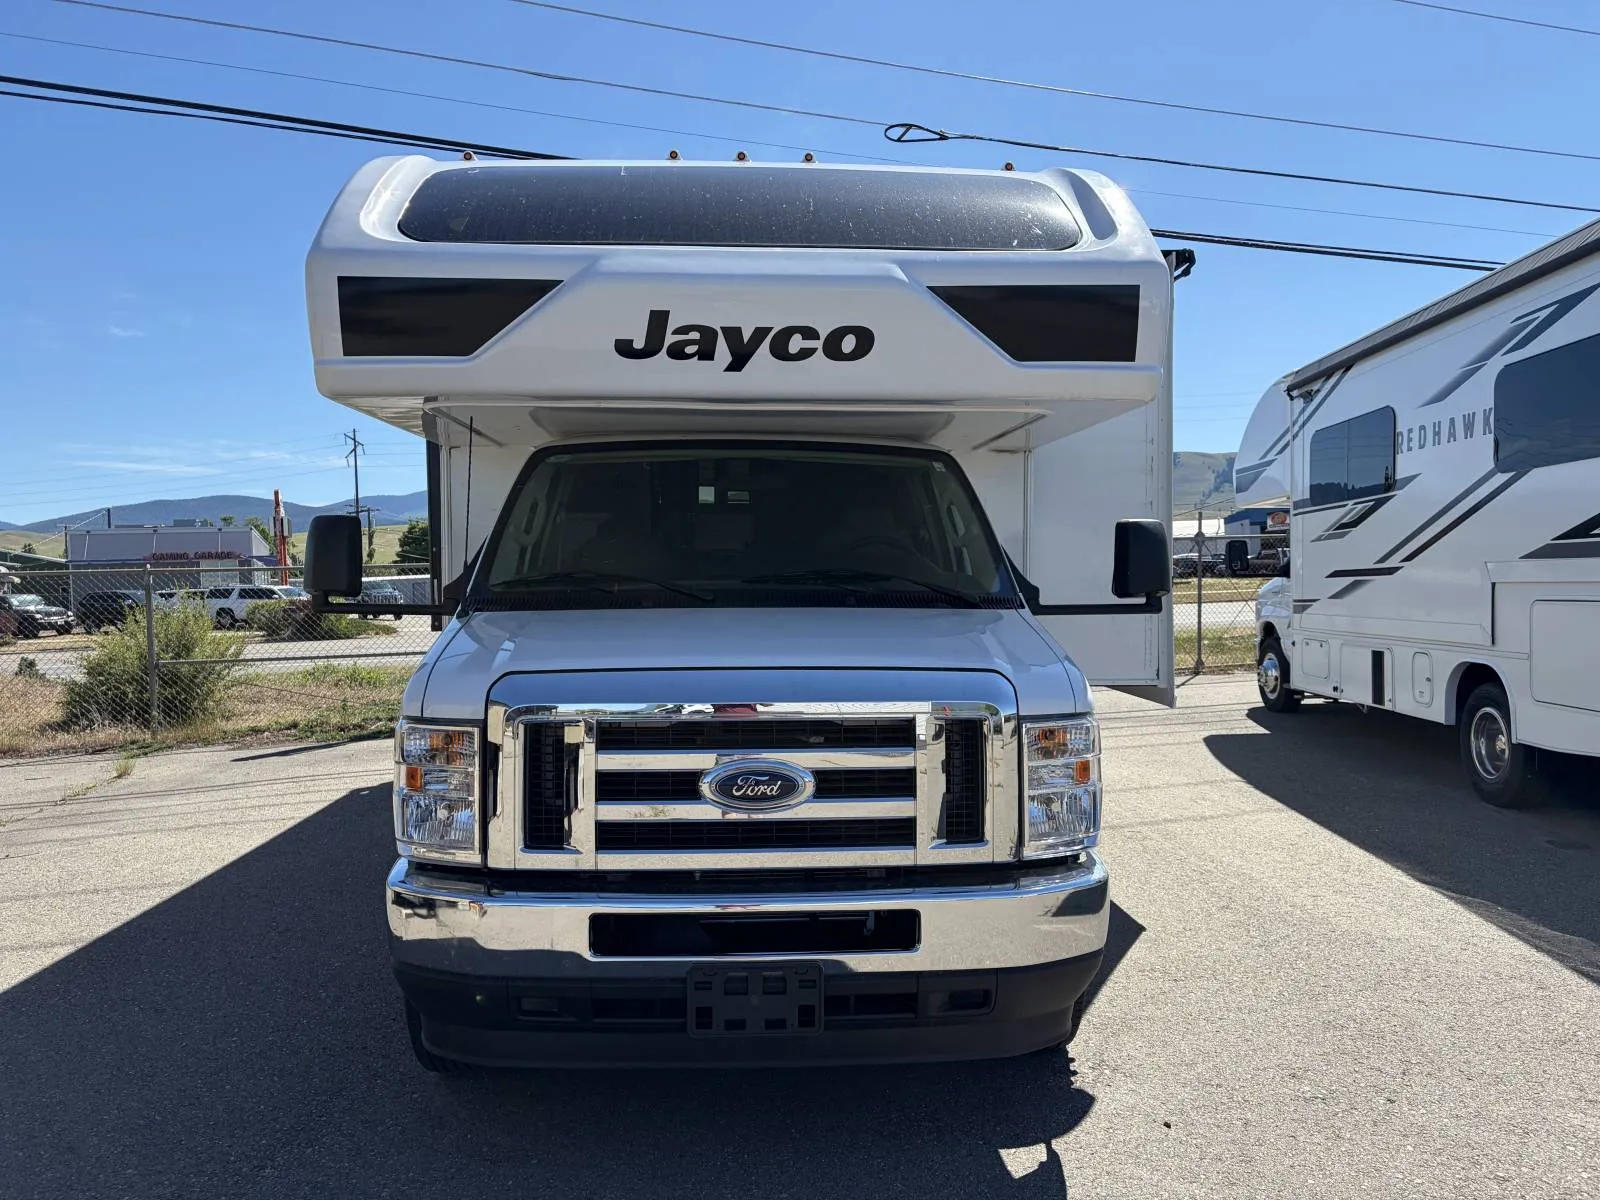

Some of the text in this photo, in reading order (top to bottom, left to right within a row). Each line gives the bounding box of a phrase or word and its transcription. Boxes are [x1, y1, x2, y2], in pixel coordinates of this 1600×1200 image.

[614, 309, 875, 372] Jayco
[1396, 407, 1493, 455] REDHAWK
[193, 551, 233, 560] GARAGE
[732, 775, 782, 796] Ford
